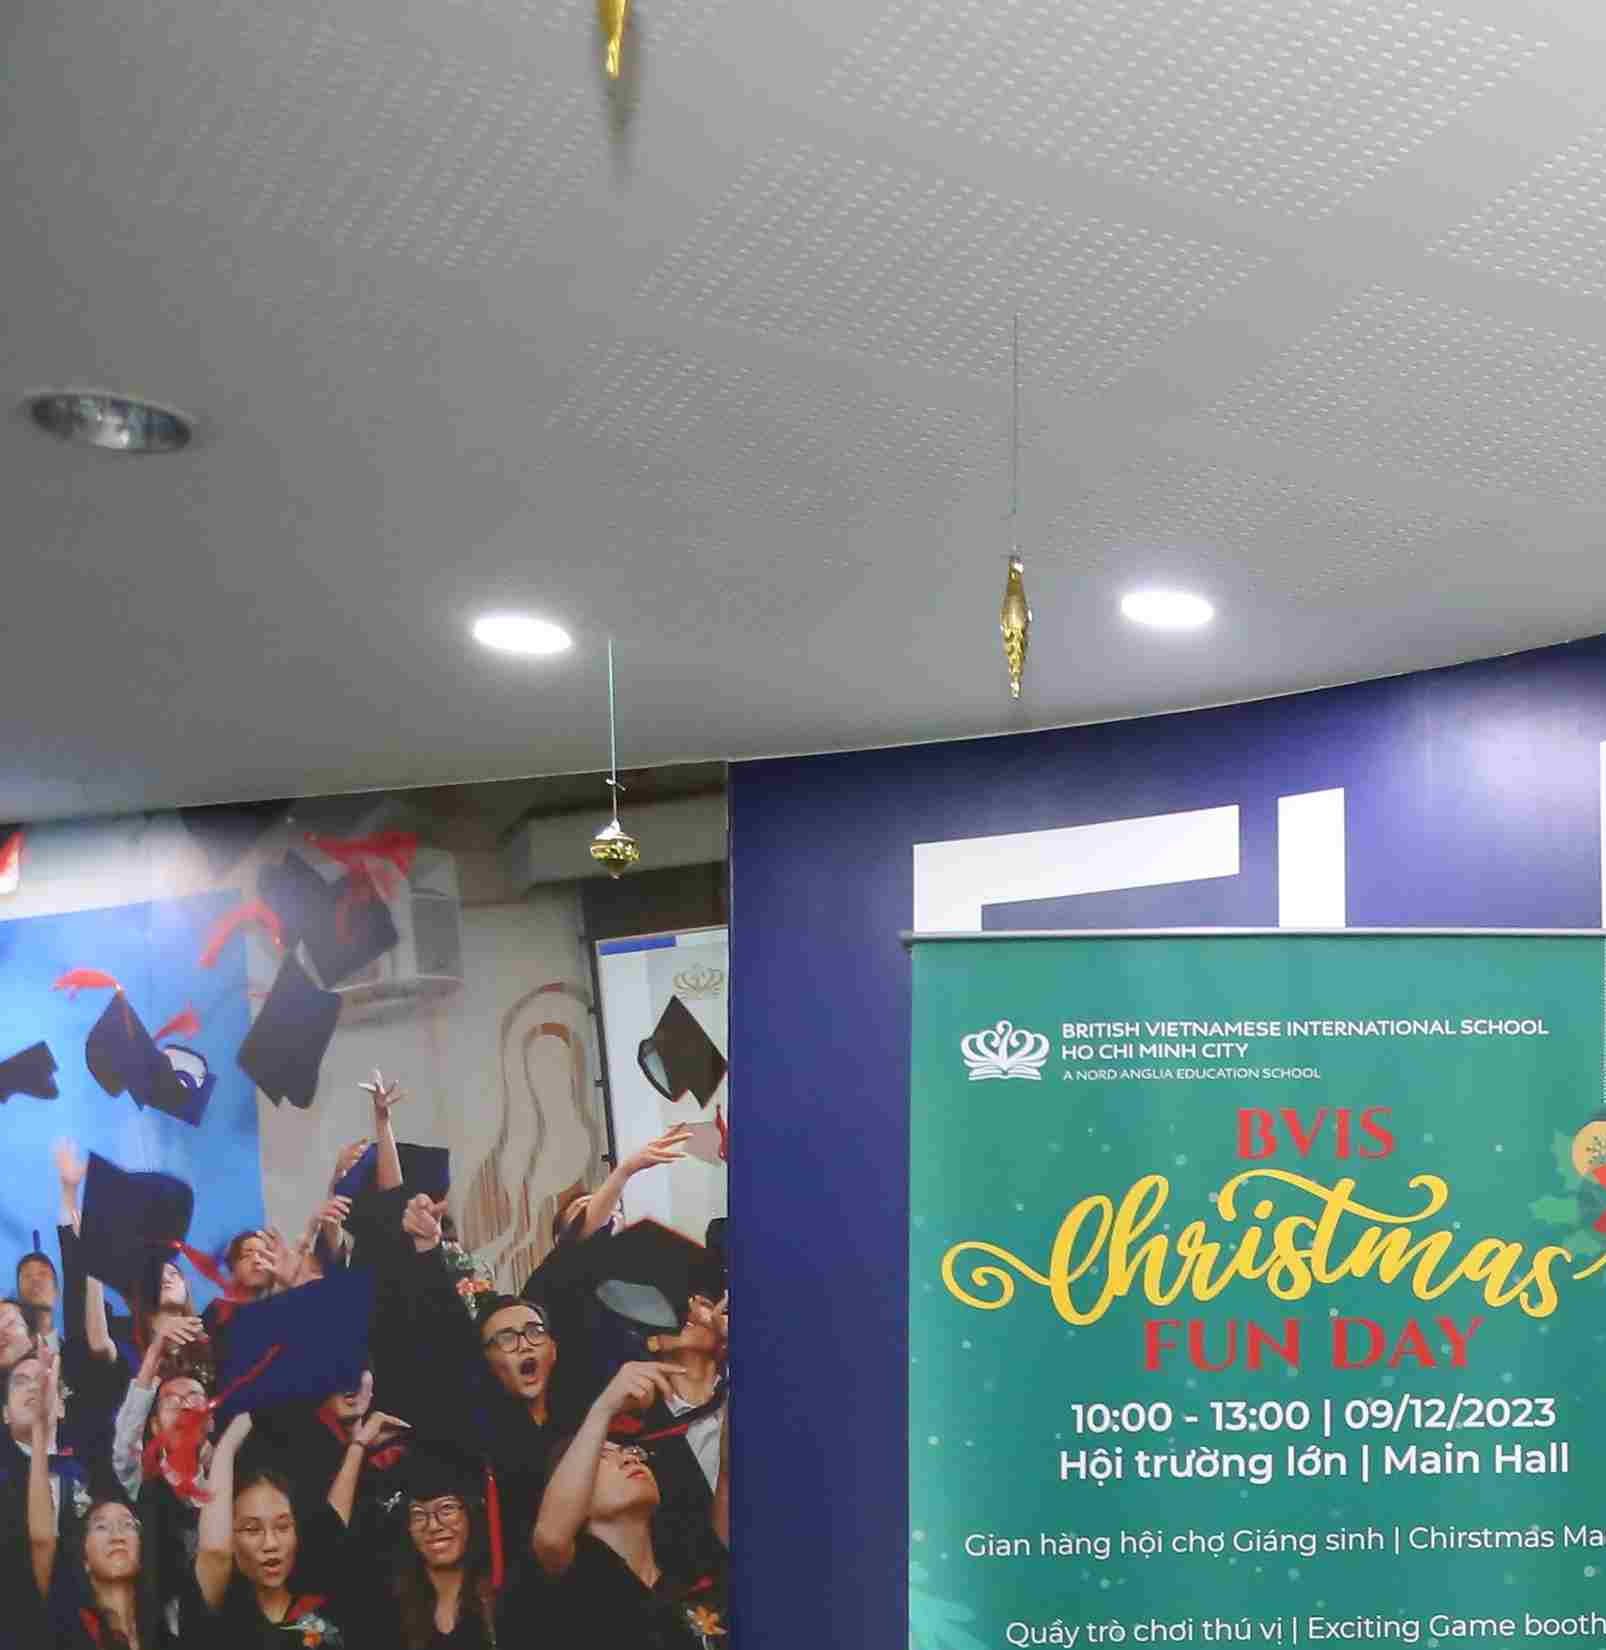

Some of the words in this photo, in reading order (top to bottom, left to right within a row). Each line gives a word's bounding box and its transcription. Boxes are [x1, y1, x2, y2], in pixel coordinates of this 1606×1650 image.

[1062, 1021, 1140, 1039] BRITISH
[1144, 1020, 1281, 1038] VIETNAMESE
[1286, 1019, 1457, 1037] INTERNATIONAL
[1460, 1019, 1549, 1035] SCHOOL
[1061, 1044, 1094, 1060] HO
[1098, 1043, 1134, 1060] CHI
[1139, 1043, 1196, 1058] MINH
[1201, 1042, 1249, 1058] CITY
[1063, 1070, 1074, 1081] A
[1076, 1068, 1118, 1081] NORD
[1119, 1068, 1174, 1080] ANGLIA
[1176, 1067, 1260, 1080] EDUCATION
[1262, 1067, 1321, 1079] SCHOOL
[1236, 1107, 1396, 1160] BVIS
[942, 1168, 1575, 1325] Christmas
[1143, 1318, 1301, 1371] FUN
[1331, 1317, 1485, 1369] DAY
[1070, 1401, 1173, 1434] 10:00
[1209, 1400, 1311, 1432] 13:00
[1343, 1392, 1557, 1433] 09/12/2023
[1059, 1446, 1123, 1487] Hội
[1134, 1446, 1273, 1485] trường
[1287, 1444, 1347, 1477] lớn
[1384, 1441, 1480, 1475] Main
[1494, 1441, 1569, 1474] Hall
[964, 1533, 1030, 1557] Gian
[1040, 1532, 1111, 1560] hàng
[1120, 1530, 1163, 1559] hội
[1171, 1529, 1225, 1558] chợ
[1232, 1528, 1317, 1557] Giáng
[1325, 1526, 1384, 1551] sinh
[1408, 1525, 1555, 1550] Chirstmas
[1086, 1619, 1126, 1643] trò
[1133, 1618, 1193, 1642] chơi
[1201, 1617, 1252, 1641] thú
[1259, 1616, 1282, 1645] vị
[1308, 1615, 1420, 1643] Exciting
[1429, 1614, 1516, 1637] Game
